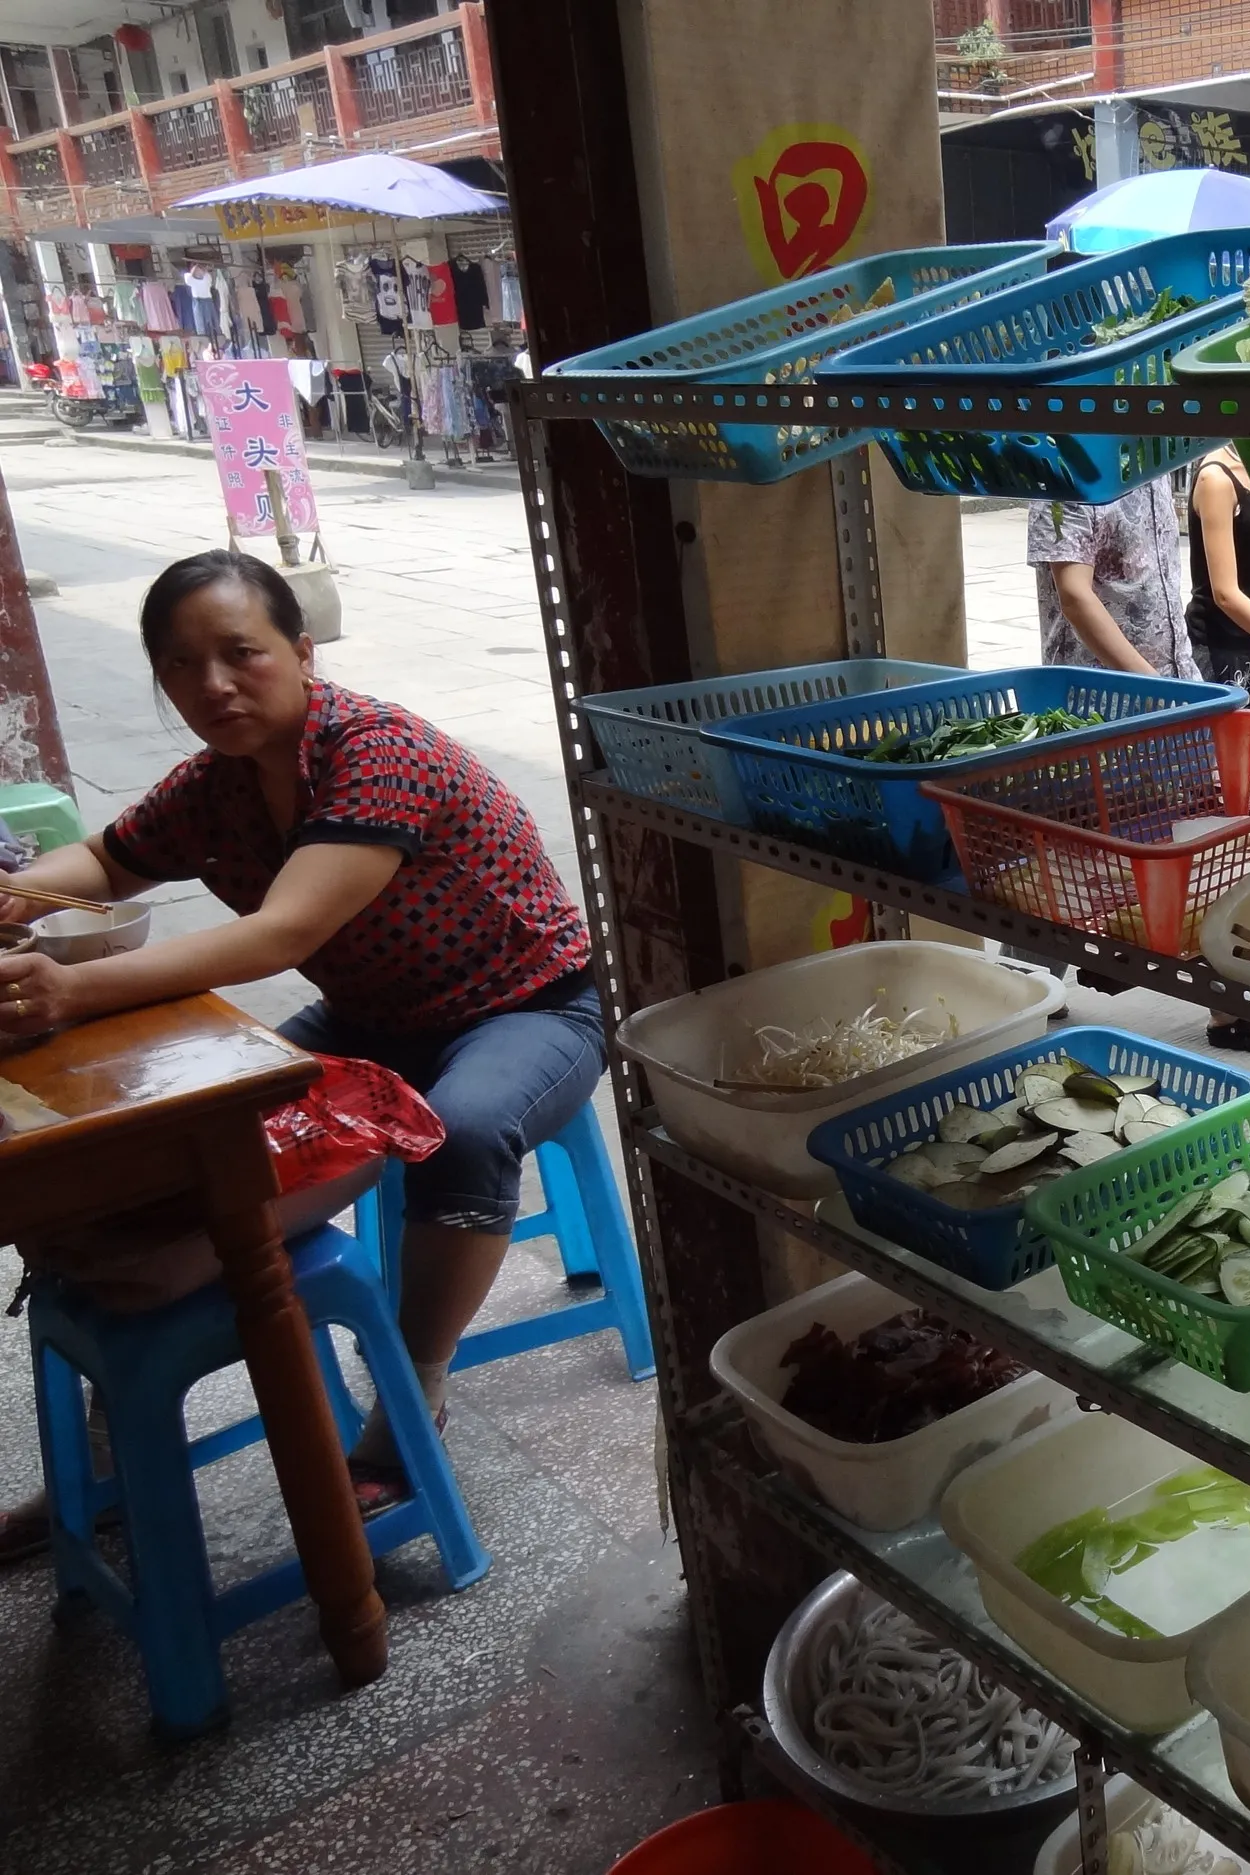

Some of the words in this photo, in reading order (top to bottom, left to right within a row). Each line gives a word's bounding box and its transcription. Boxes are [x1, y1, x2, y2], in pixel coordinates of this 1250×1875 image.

[215, 417, 244, 488] 证件照
[280, 414, 305, 482] 非主流
